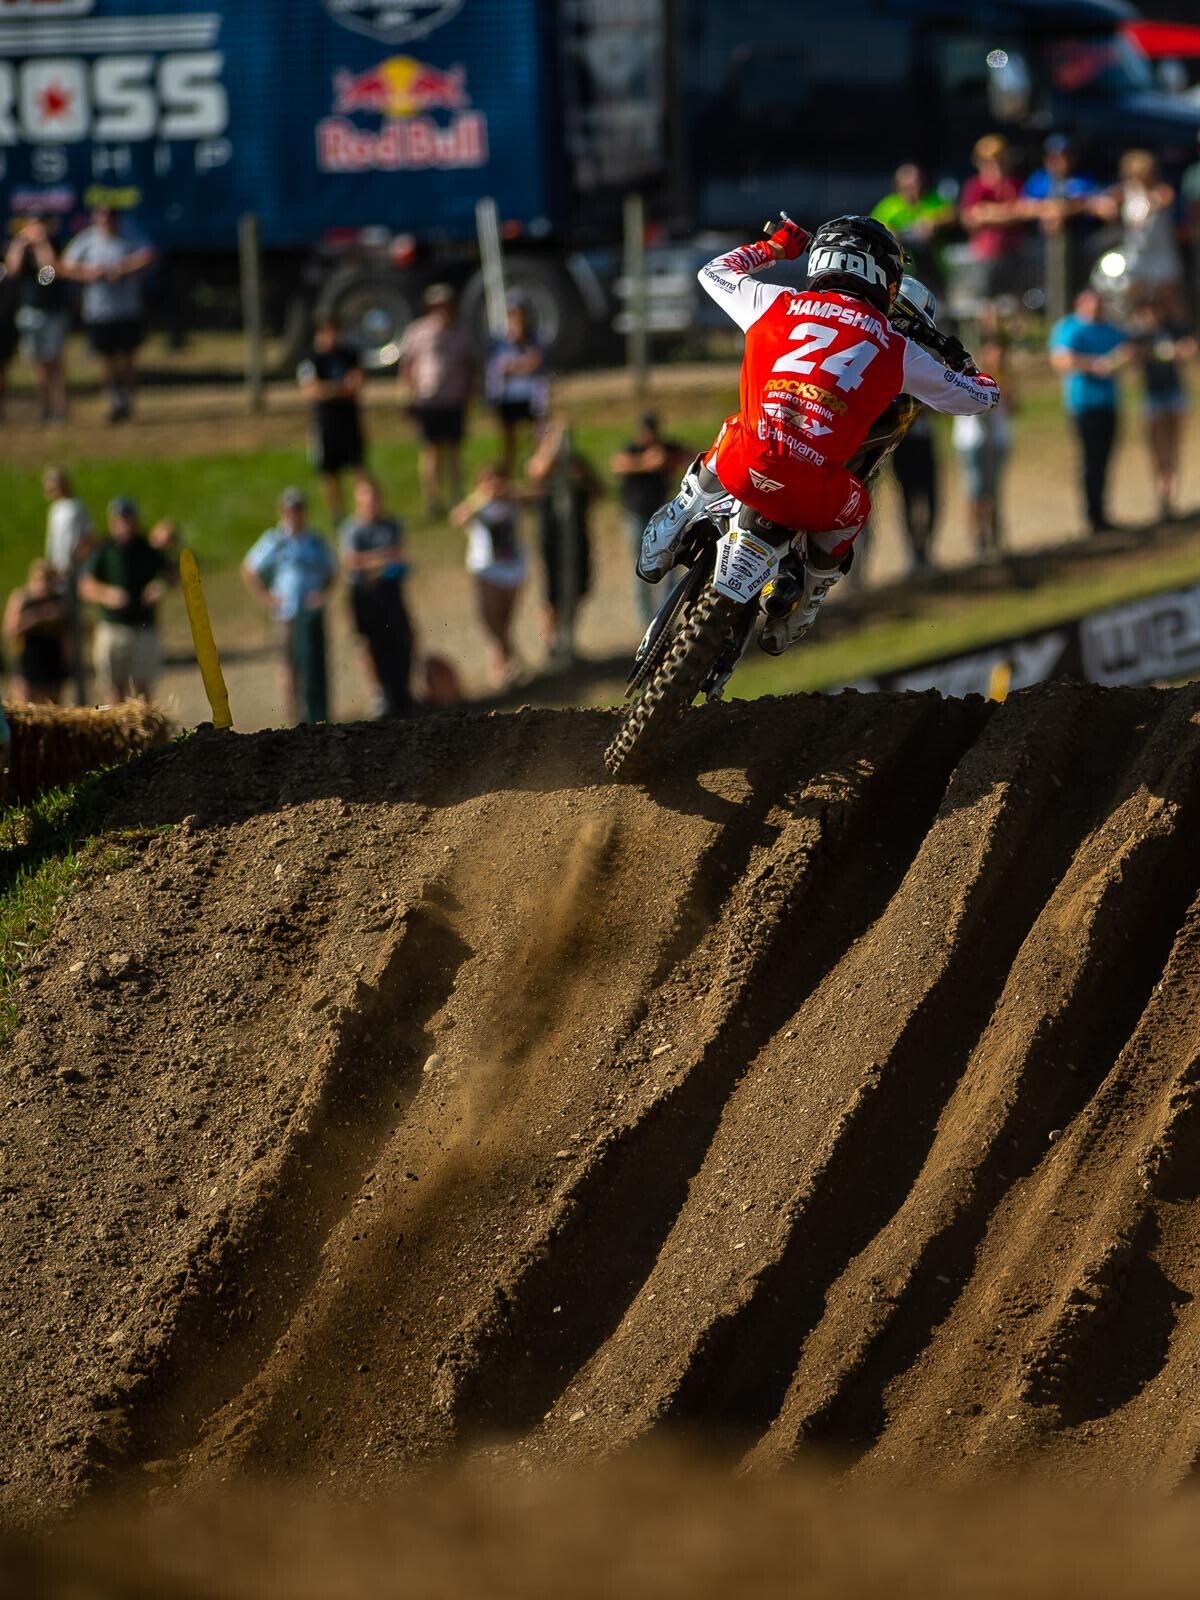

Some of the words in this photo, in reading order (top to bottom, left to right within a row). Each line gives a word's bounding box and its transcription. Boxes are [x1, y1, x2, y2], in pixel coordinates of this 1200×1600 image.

[0, 51, 229, 147] OSS
[316, 116, 399, 173] Red
[400, 110, 489, 170] Bull
[786, 299, 890, 349] HAMPSHIRE
[771, 322, 880, 393] 24
[763, 379, 848, 417] ROCKSTAR
[767, 391, 807, 407] ENERGY
[805, 401, 834, 422] DRINK
[766, 425, 826, 467] Husqvarna
[719, 544, 731, 577] DUNLOP
[747, 567, 772, 593] DUNLOP
